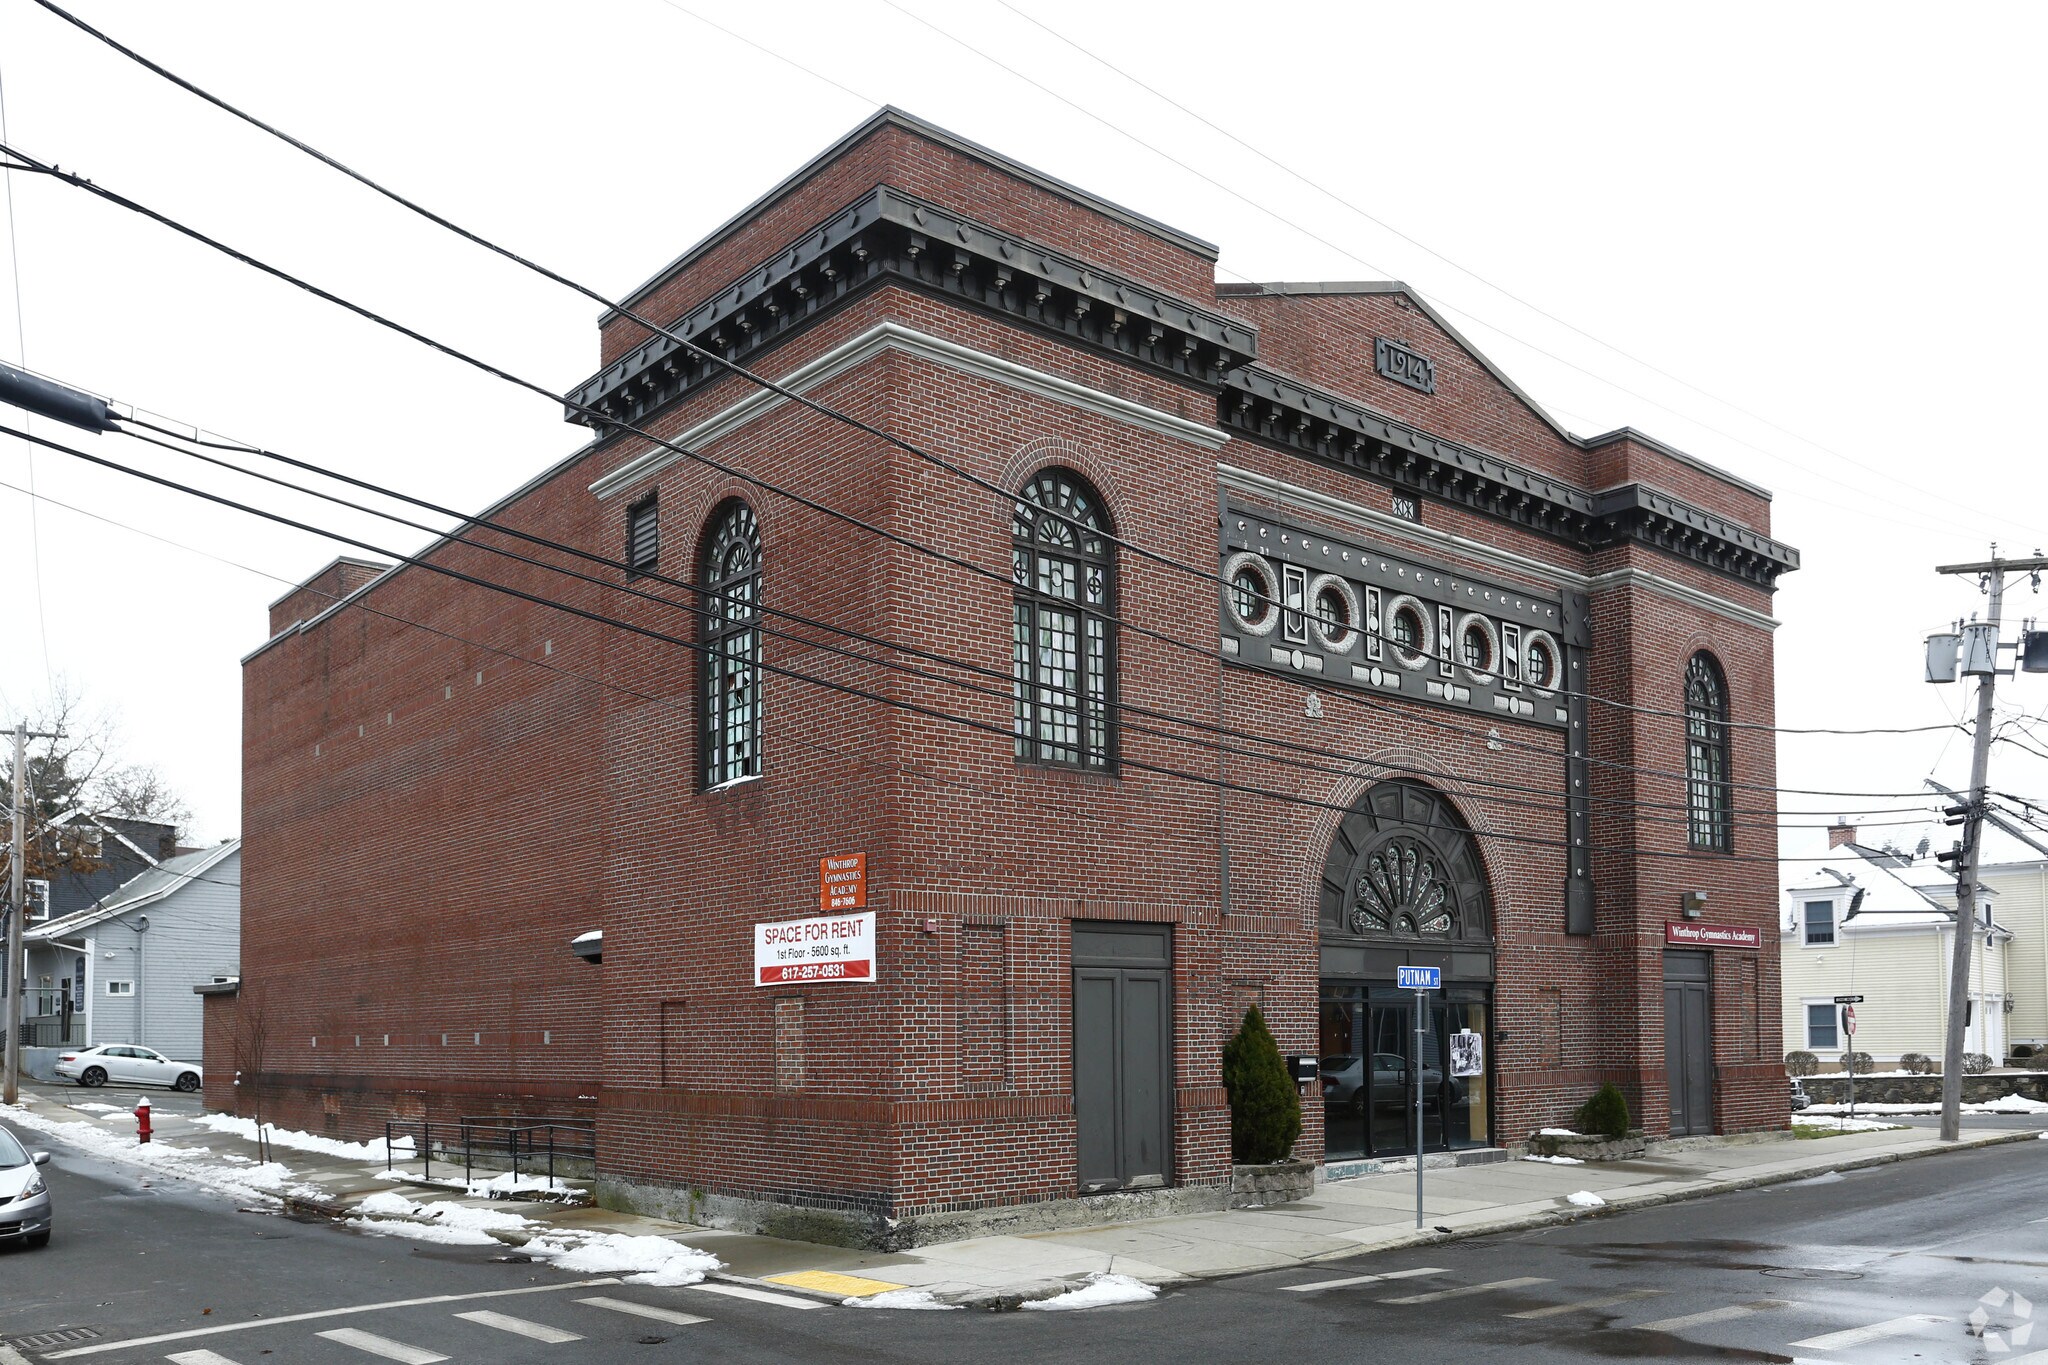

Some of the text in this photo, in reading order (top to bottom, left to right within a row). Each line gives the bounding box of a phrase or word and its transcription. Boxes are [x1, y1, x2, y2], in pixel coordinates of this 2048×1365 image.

[1389, 348, 1425, 383] 1914
[827, 858, 859, 870] WINTHROP
[824, 871, 862, 884] GYMNASTICS
[765, 919, 864, 945] SPACE FOR RENT
[1672, 925, 1756, 944] Winthrop Gymnastics Academy
[777, 949, 787, 959] 1st
[788, 947, 805, 959] Floor
[811, 945, 829, 957] 5600
[831, 947, 842, 958] sq.
[843, 944, 851, 955] ft.
[781, 963, 845, 980] 617-257-0531
[1399, 969, 1439, 986] PUTNAM ST
